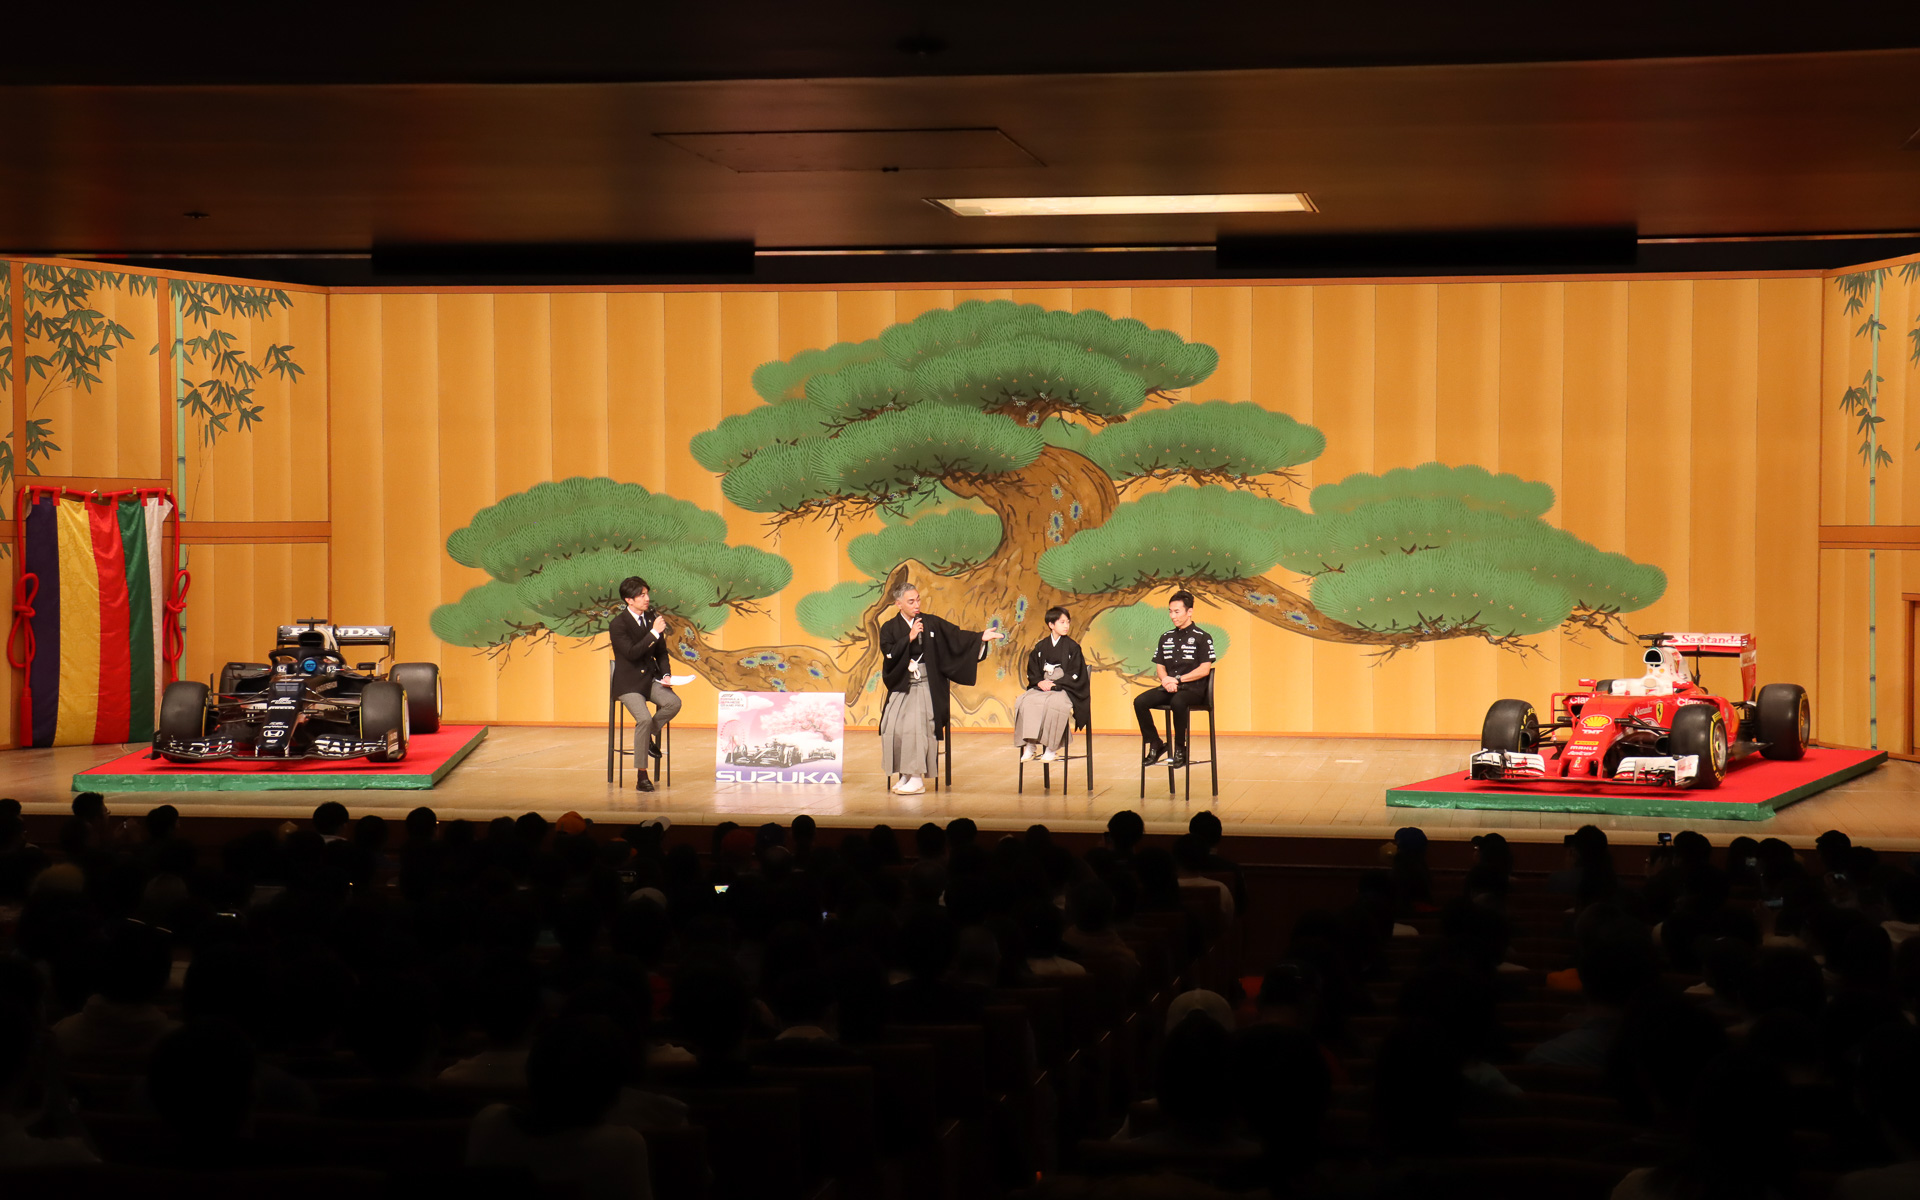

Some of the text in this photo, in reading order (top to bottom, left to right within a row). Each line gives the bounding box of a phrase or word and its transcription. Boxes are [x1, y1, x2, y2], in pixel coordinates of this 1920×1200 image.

[289, 627, 383, 636] HNDA
[1681, 634, 1741, 645] Santande
[1569, 696, 1590, 704] Clar
[716, 771, 841, 783] SUZUKA
